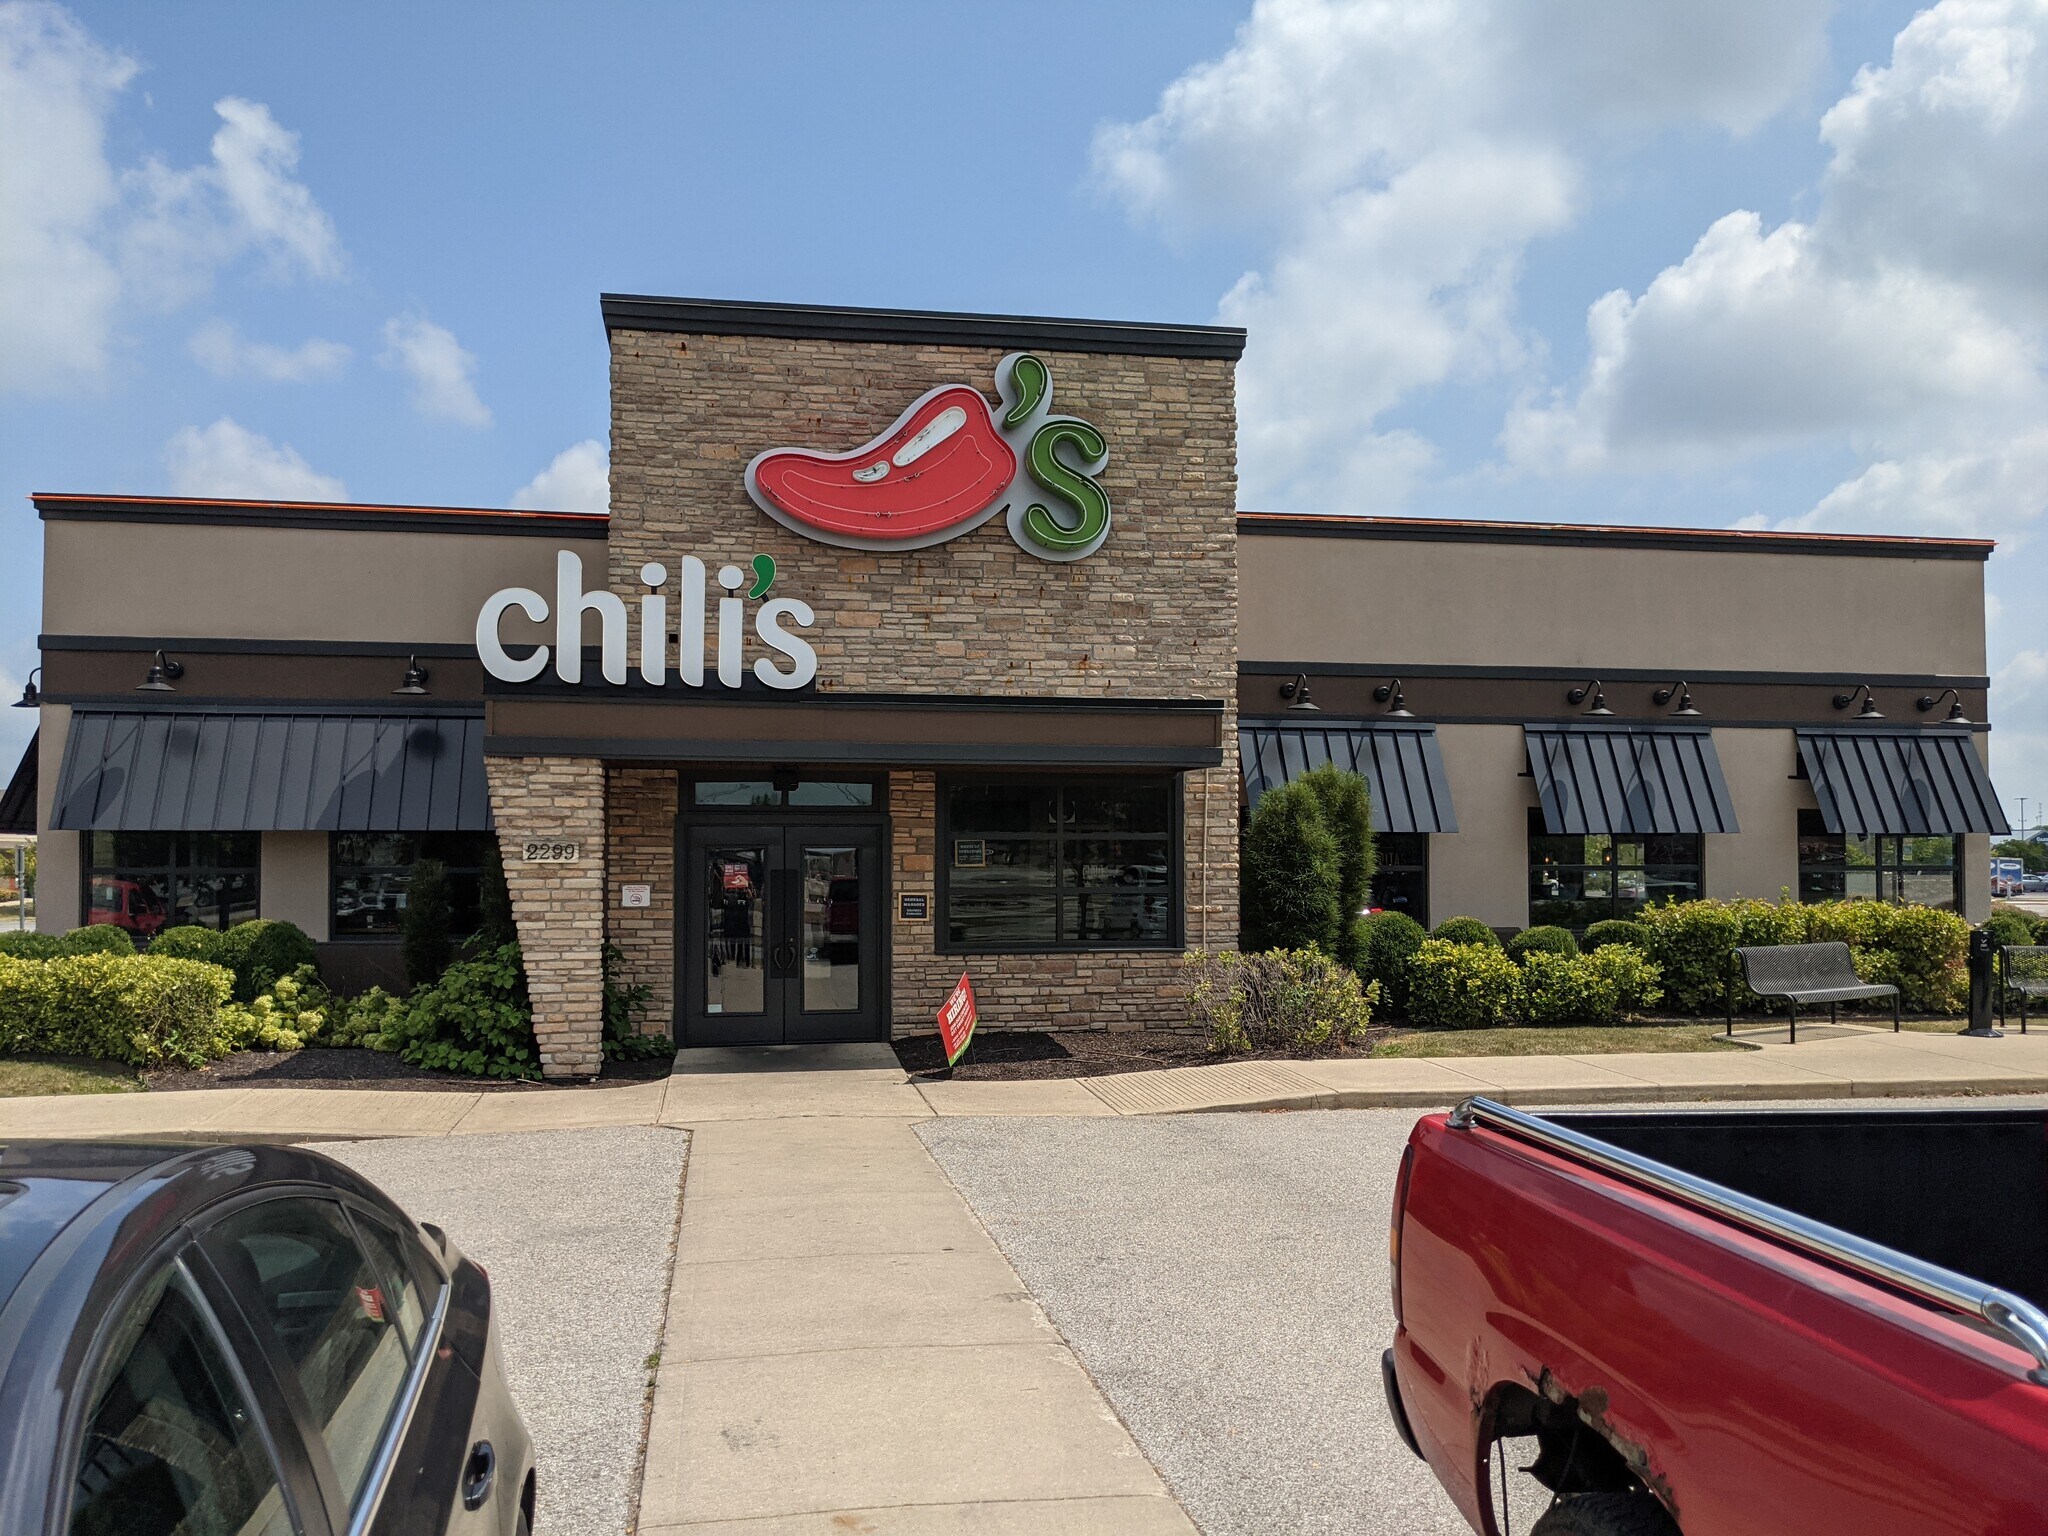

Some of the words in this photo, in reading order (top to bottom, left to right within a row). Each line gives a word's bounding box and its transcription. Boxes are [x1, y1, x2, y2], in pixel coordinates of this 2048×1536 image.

[476, 550, 817, 690] chili's
[526, 843, 575, 860] 2299
[946, 987, 967, 1025] HIRING
